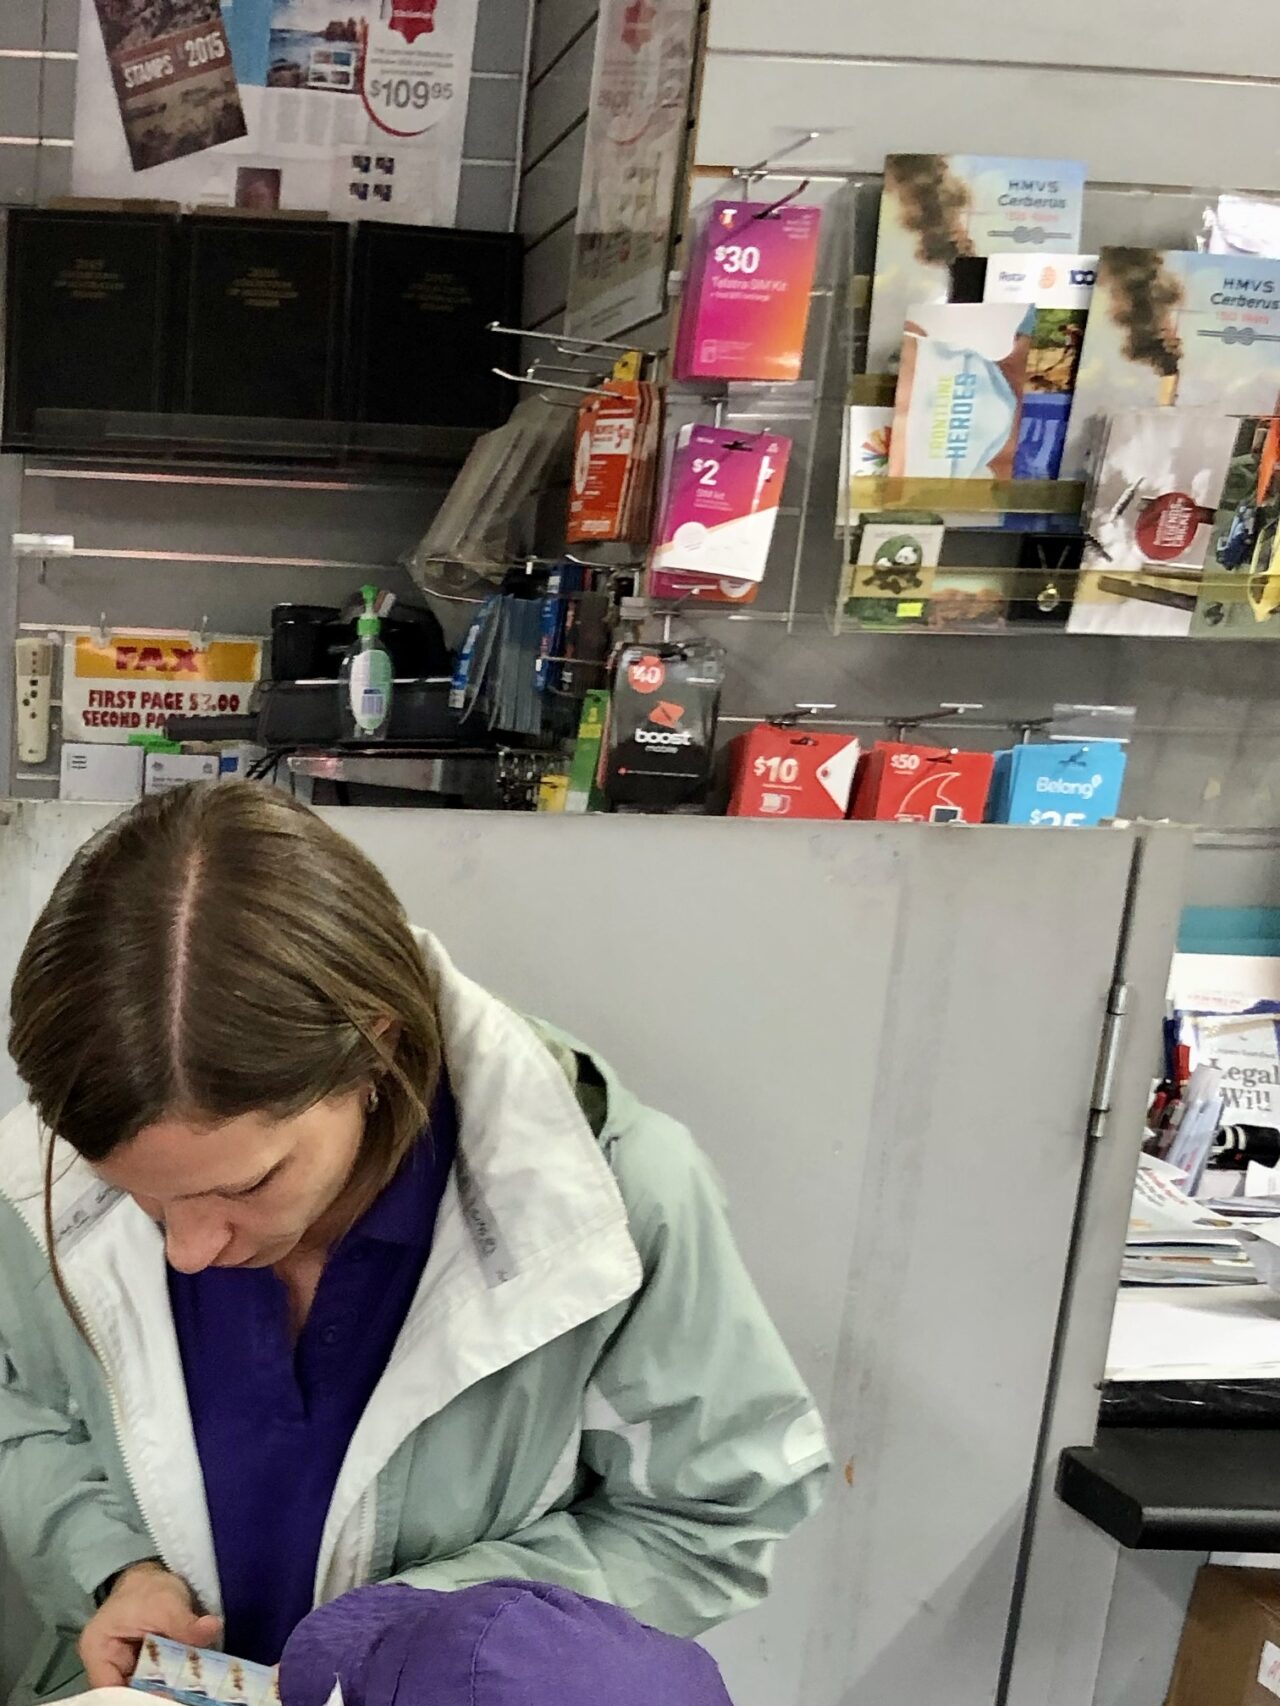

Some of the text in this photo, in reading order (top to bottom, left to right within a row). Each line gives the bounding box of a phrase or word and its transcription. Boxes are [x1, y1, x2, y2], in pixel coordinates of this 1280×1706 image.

[124, 54, 174, 89] STAMPS
[1008, 180, 1059, 193] HMVS
[714, 245, 761, 274] $30
[1223, 278, 1275, 293] HMVS
[1210, 292, 1280, 309] Cerberus
[946, 373, 977, 459] HEROES
[691, 458, 719, 486] $2
[116, 646, 199, 672] FAX
[89, 689, 136, 709] FIRST
[140, 691, 184, 711] PAGE
[82, 710, 140, 729] SECOND
[635, 728, 692, 745] boost
[753, 756, 799, 783] $10
[890, 754, 920, 770] $50
[1207, 1057, 1280, 1088] Legal
